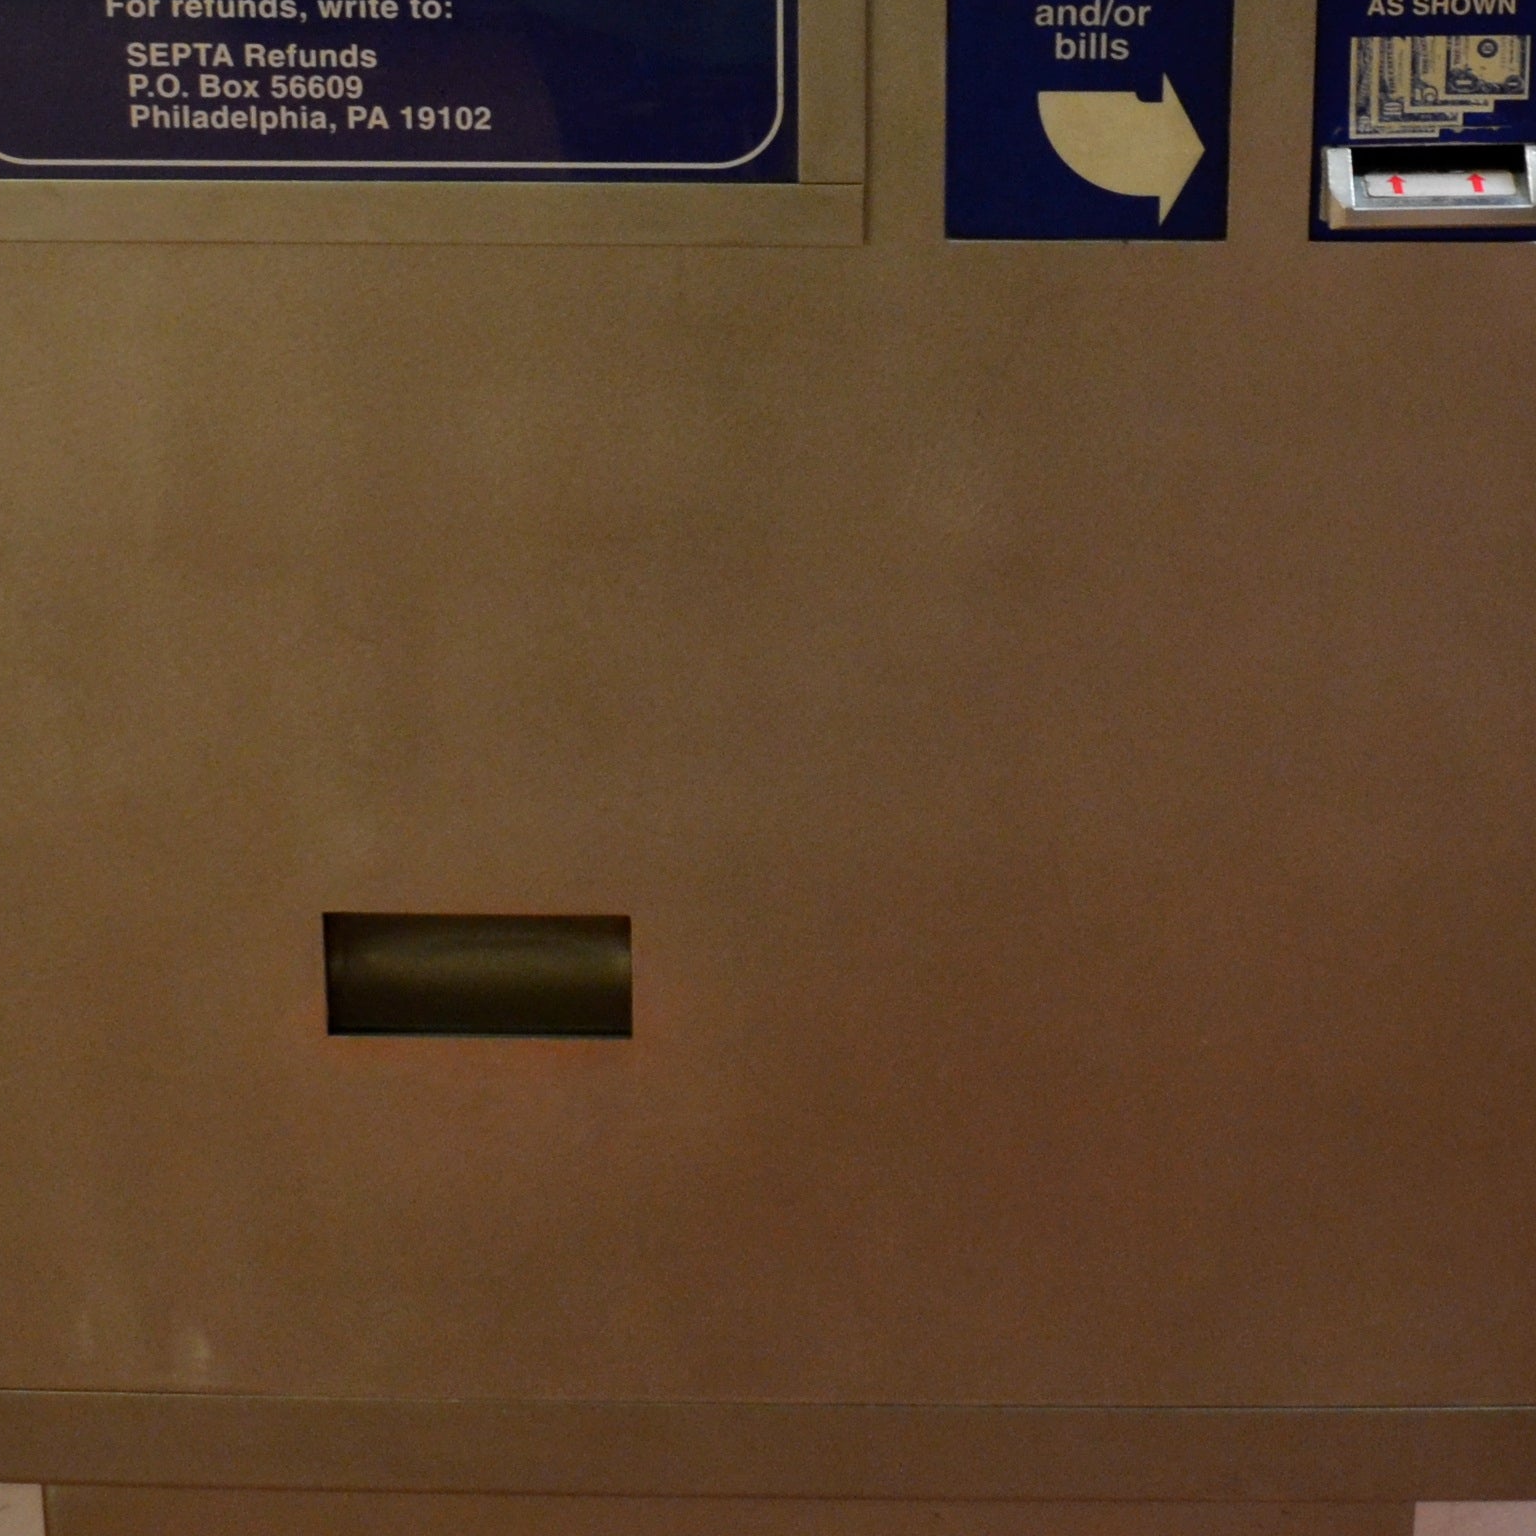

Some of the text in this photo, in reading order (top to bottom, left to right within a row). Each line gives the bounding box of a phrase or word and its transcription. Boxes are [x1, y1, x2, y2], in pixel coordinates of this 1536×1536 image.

[127, 42, 377, 68] SEPTA Refunds
[1055, 32, 1129, 60] bills
[129, 73, 363, 99] P.O. Box 56609
[130, 105, 491, 135] Philadelphia, PA 19102
